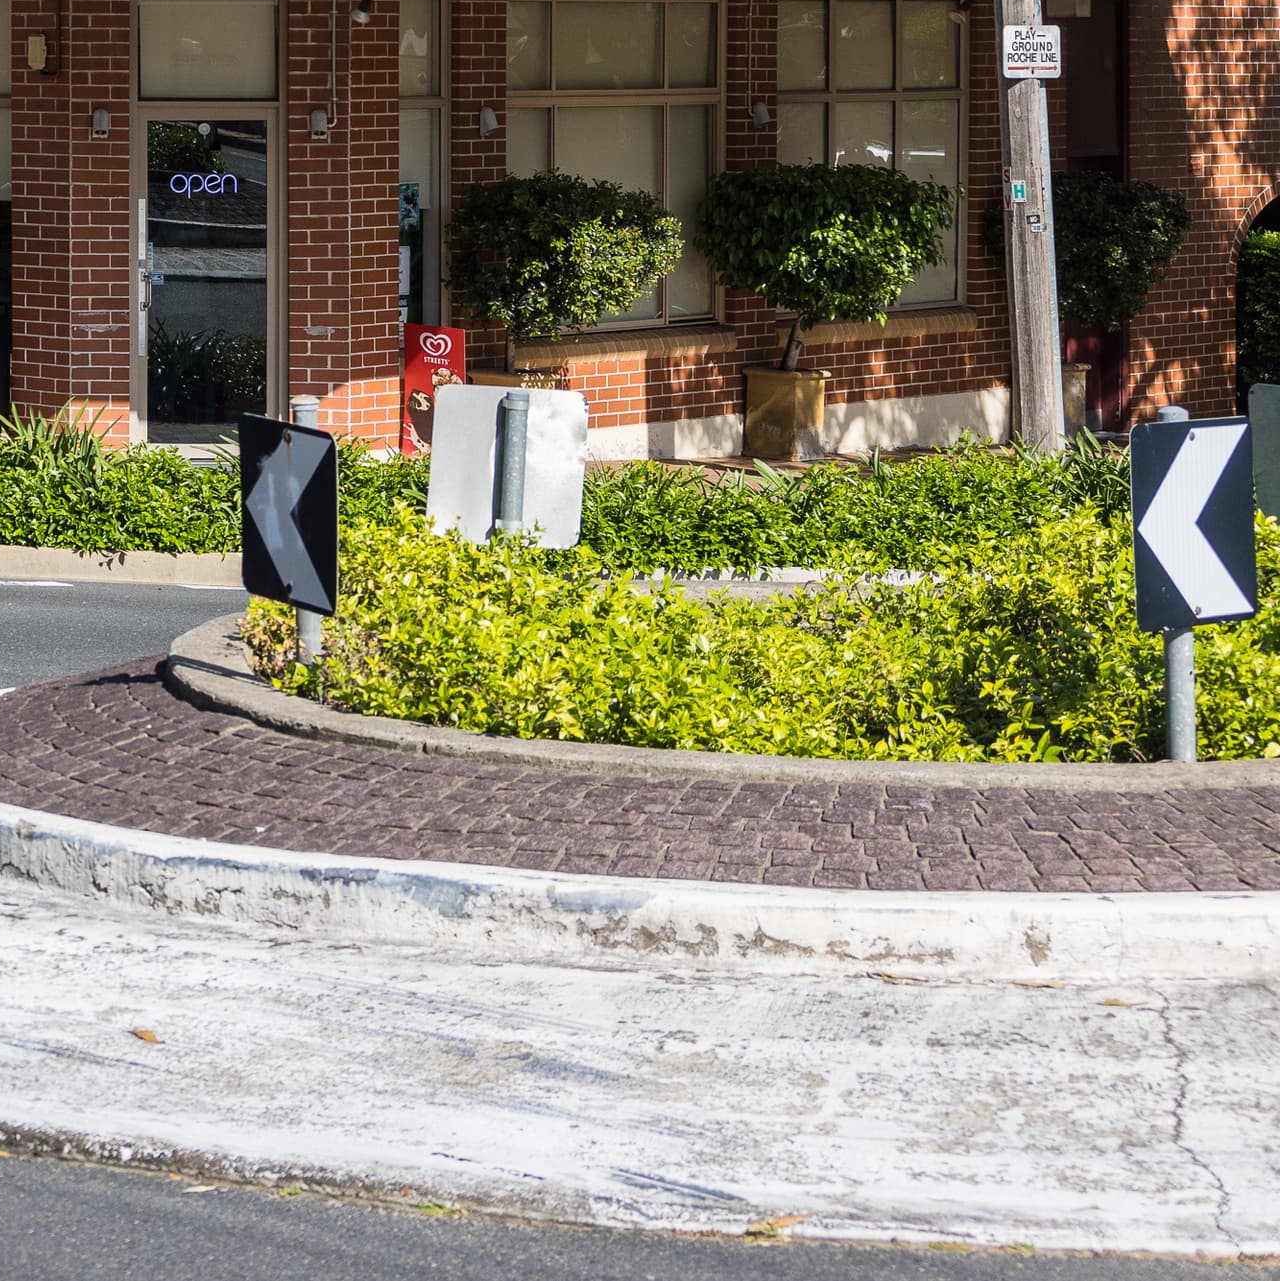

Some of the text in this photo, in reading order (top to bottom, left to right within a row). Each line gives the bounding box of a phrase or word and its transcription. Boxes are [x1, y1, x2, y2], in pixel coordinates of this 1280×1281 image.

[1011, 41, 1053, 52] GROUND
[1007, 52, 1038, 63] ROCHE
[169, 173, 238, 199] open
[1013, 183, 1025, 199] H
[423, 356, 449, 366] STREETS
